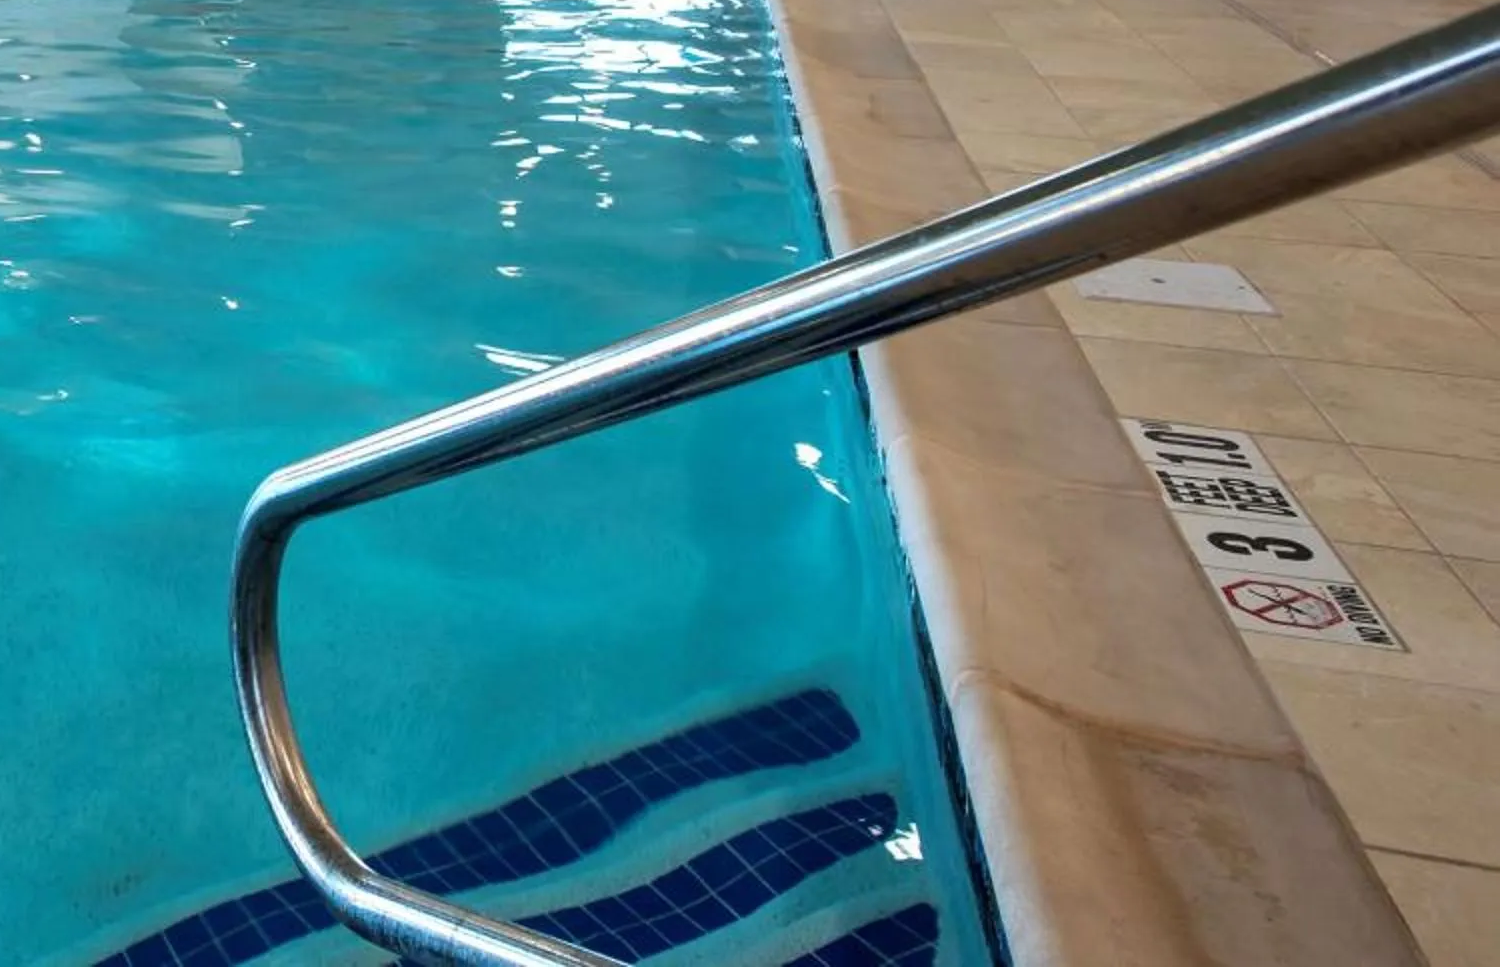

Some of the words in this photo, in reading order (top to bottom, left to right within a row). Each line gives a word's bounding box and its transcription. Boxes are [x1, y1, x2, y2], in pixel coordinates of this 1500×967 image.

[1155, 470, 1233, 509] FEET
[1218, 478, 1298, 517] DEEP
[1206, 532, 1314, 561] 3
[1325, 585, 1381, 625] DIVING
[1355, 626, 1396, 646] NO
